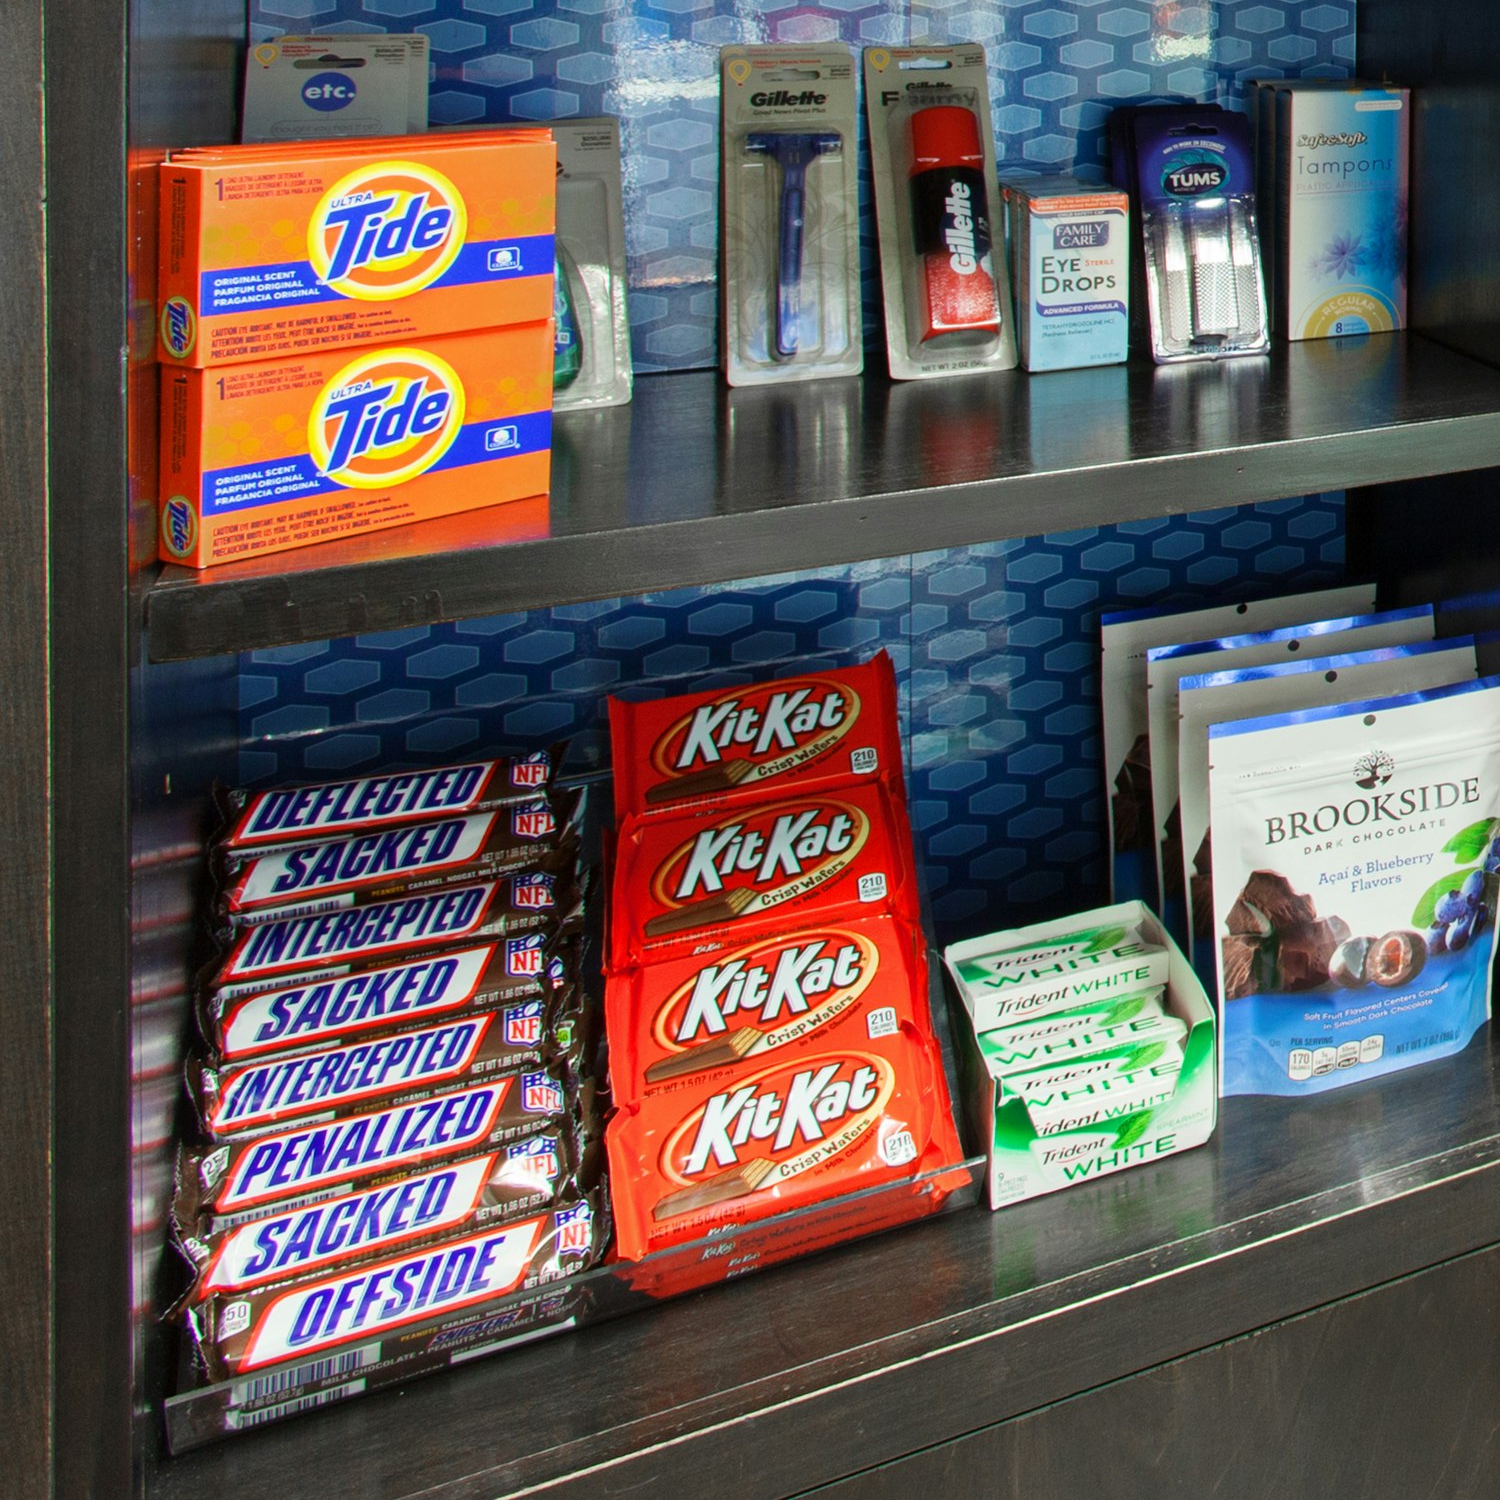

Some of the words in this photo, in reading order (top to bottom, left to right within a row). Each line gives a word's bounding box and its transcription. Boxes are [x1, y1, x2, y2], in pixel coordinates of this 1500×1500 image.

[304, 83, 356, 100] etc.
[750, 90, 827, 107] Gillette
[1169, 171, 1221, 187] TUMS
[1297, 156, 1393, 180] Tampons
[214, 178, 224, 201] 1
[330, 191, 373, 209] ULTRA
[323, 192, 455, 284] Tide
[944, 180, 977, 276] Gillette
[1056, 222, 1104, 237] FAMILY
[1060, 235, 1098, 247] CARE
[213, 274, 263, 288] ORIGINAL
[264, 270, 297, 282] SCENT
[1041, 256, 1081, 275] EYE
[213, 283, 255, 297] PARFUM
[256, 279, 304, 292] ORIGINAL
[213, 292, 273, 307] FRAGANCIA
[273, 287, 321, 301] ORIGINAL
[1041, 274, 1117, 295] DROPS
[1043, 306, 1084, 316] ADVANCED
[1084, 302, 1120, 313] FORMULA
[1322, 296, 1377, 316] REGULAR
[167, 300, 189, 353] Tide
[1335, 321, 1343, 334] 8
[330, 380, 373, 400] ULTRA
[323, 374, 453, 476] Tide
[854, 749, 875, 760] 210
[248, 764, 486, 834] DEFLECTED
[1264, 776, 1481, 846] BROOKSIDE
[518, 812, 557, 835] NFL
[1303, 838, 1345, 856] DARK
[1352, 817, 1449, 845] CHOCOLATE
[271, 819, 468, 894] SACKED
[1351, 864, 1363, 878] &
[1366, 850, 1435, 876] Blueberry
[1350, 872, 1402, 894] Flavors
[245, 886, 487, 968] INTERCEPTED
[983, 941, 1146, 988] WHITE
[992, 943, 1077, 971] Trident
[254, 958, 461, 1042] SACKED
[996, 984, 1070, 1017] Trident
[1072, 965, 1151, 996] WHITE
[766, 1022, 806, 1048] Crisp
[806, 993, 854, 1027] Wafers
[870, 1011, 893, 1025] 210
[1303, 1012, 1321, 1022] Soft
[1322, 1009, 1344, 1022] Fruit
[1344, 1000, 1383, 1018] Flavored
[1383, 991, 1417, 1008] Centers
[1322, 1021, 1333, 1031] In
[1333, 1015, 1367, 1030] Smooth
[1368, 1008, 1389, 1022] Dark
[1389, 996, 1434, 1016] Chocolate
[224, 1022, 478, 1120] INTERCEPTED
[1292, 1052, 1311, 1066] 170
[1024, 1060, 1112, 1092] Trident
[1024, 1059, 1182, 1108] WHITE
[528, 1086, 563, 1111] NFL
[235, 1089, 496, 1197] PENALIZED
[779, 1150, 822, 1178] Crisp
[822, 1117, 873, 1155] Wafers
[1042, 1137, 1107, 1165] Trident
[1062, 1133, 1178, 1181] WHITE
[239, 1170, 458, 1278] SACKED
[286, 1235, 507, 1348] OFFSIDE
